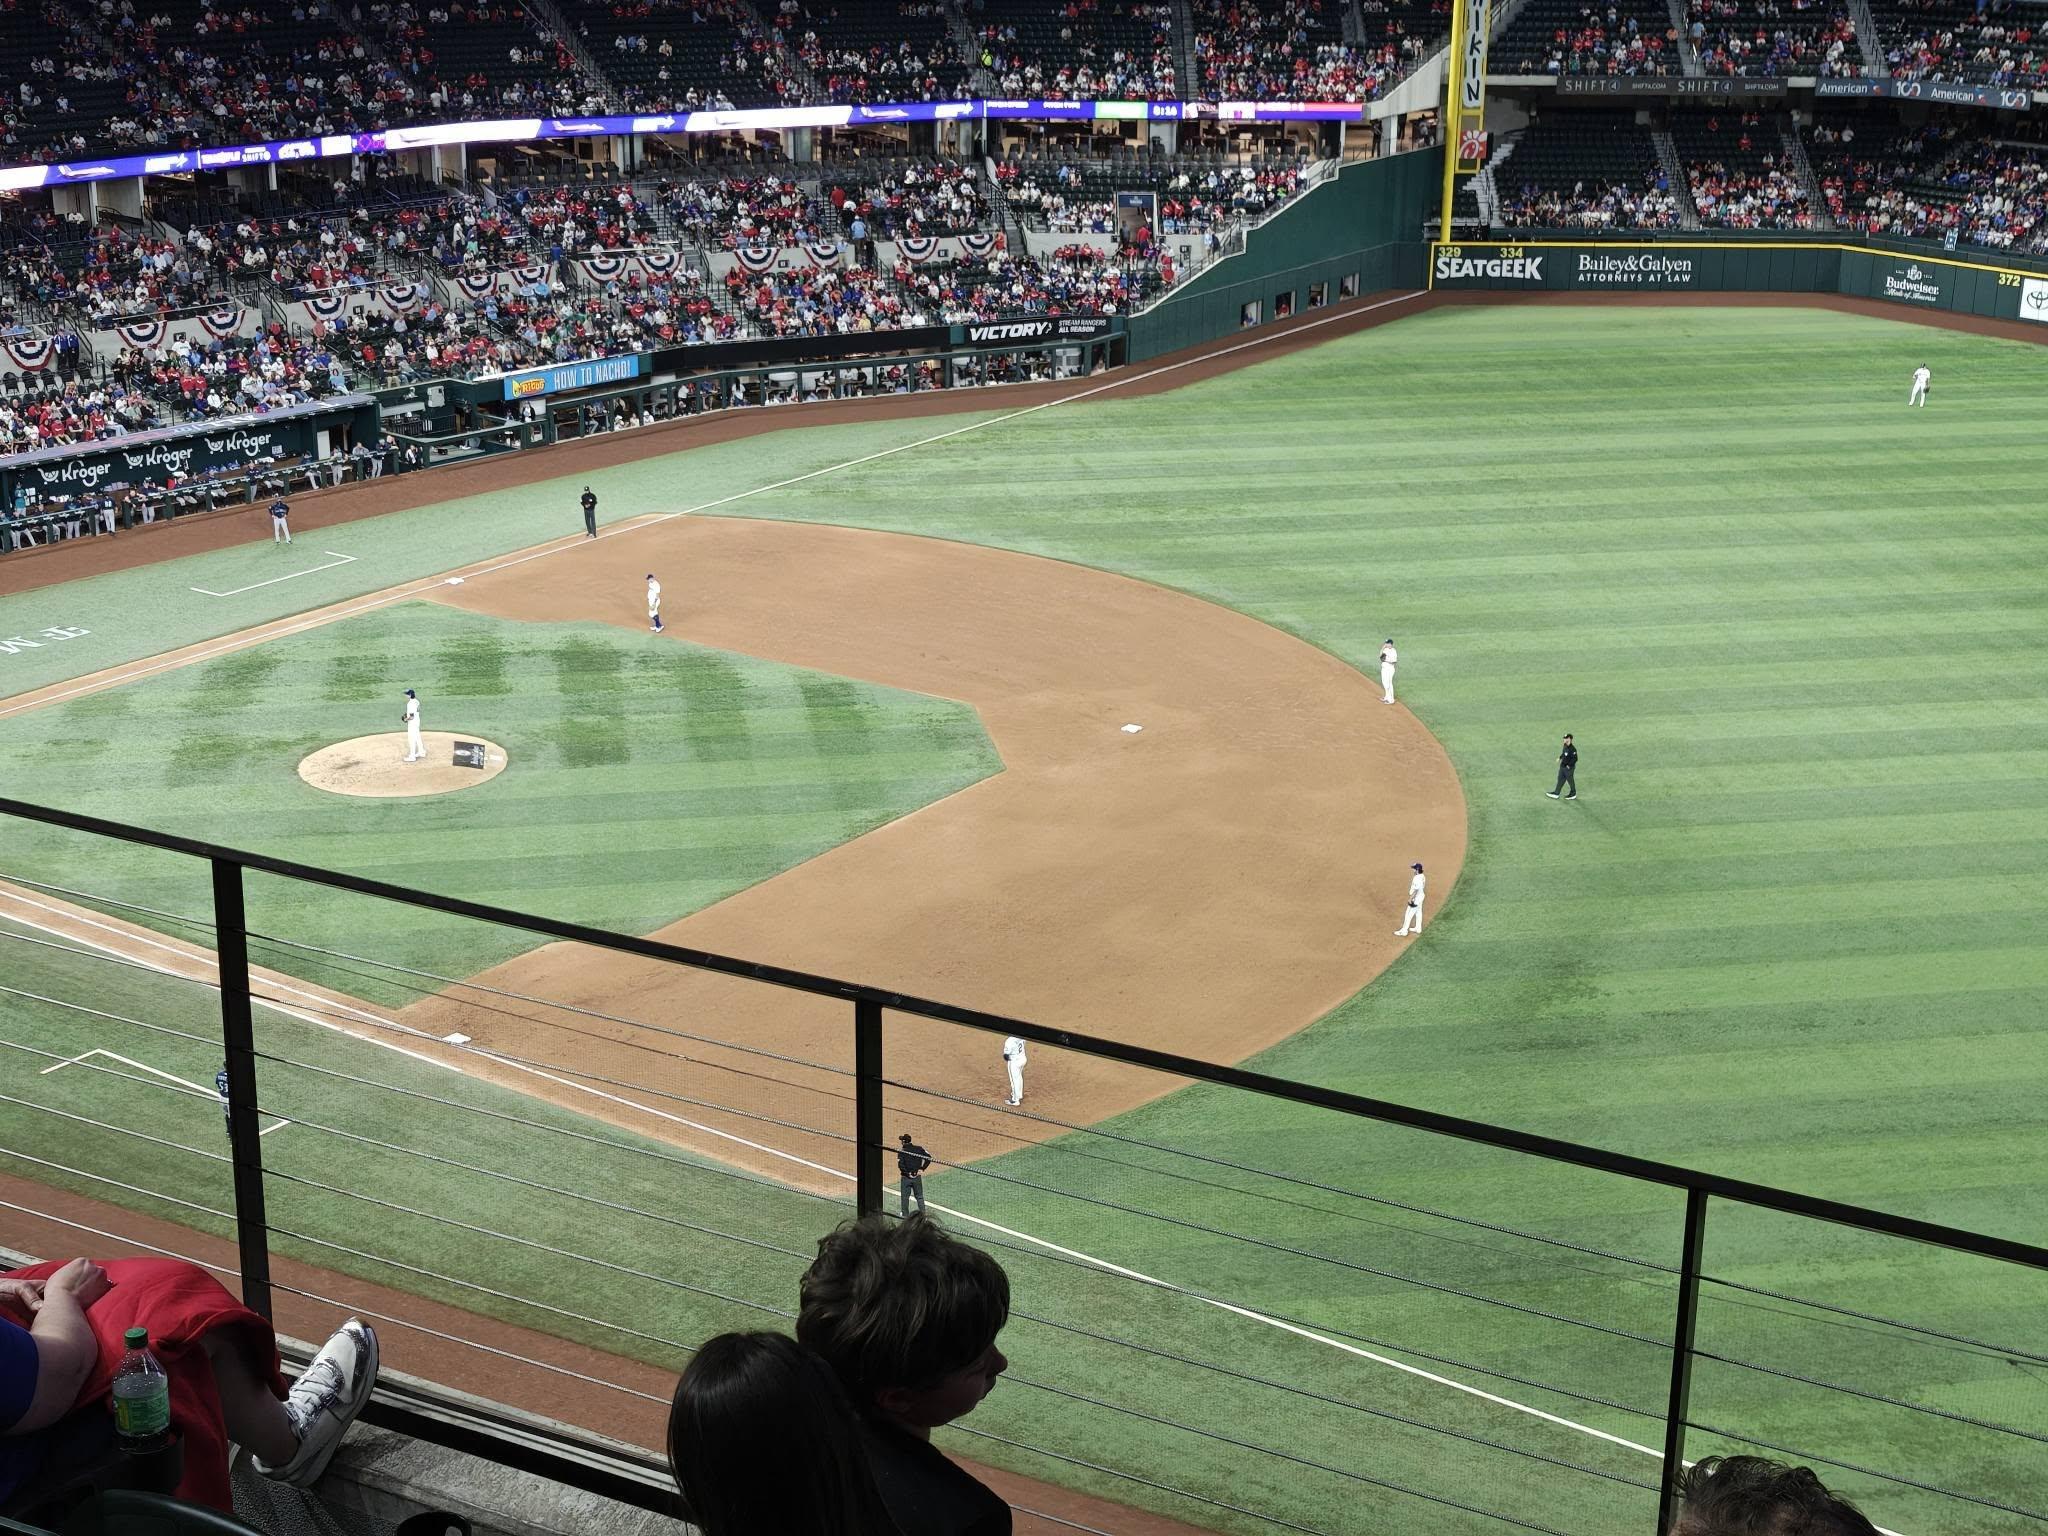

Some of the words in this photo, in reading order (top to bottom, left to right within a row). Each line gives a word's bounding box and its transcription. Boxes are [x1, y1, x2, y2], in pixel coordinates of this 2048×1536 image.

[1466, 0, 1483, 101] IKIN
[1819, 82, 1868, 94] American
[1931, 87, 1974, 102] American
[1438, 247, 1461, 258] 329
[1500, 247, 1523, 259] 334
[1436, 256, 1543, 280] SEATGEEK
[1578, 273, 1642, 282] ATTORNEYS
[1648, 273, 1662, 282] AT
[1668, 273, 1691, 283] LAW
[1886, 276, 1939, 295] Budweiser
[1998, 274, 2021, 287] 372
[1058, 319, 1080, 327] STREAM
[1058, 326, 1069, 334] ALL
[1070, 325, 1095, 333] SEASON
[554, 370, 577, 390] HOW
[581, 367, 593, 385] TO
[595, 359, 631, 382] NACHO!
[226, 430, 272, 457] Kroger
[146, 444, 193, 472] Kroger
[61, 460, 111, 487] Kroger
